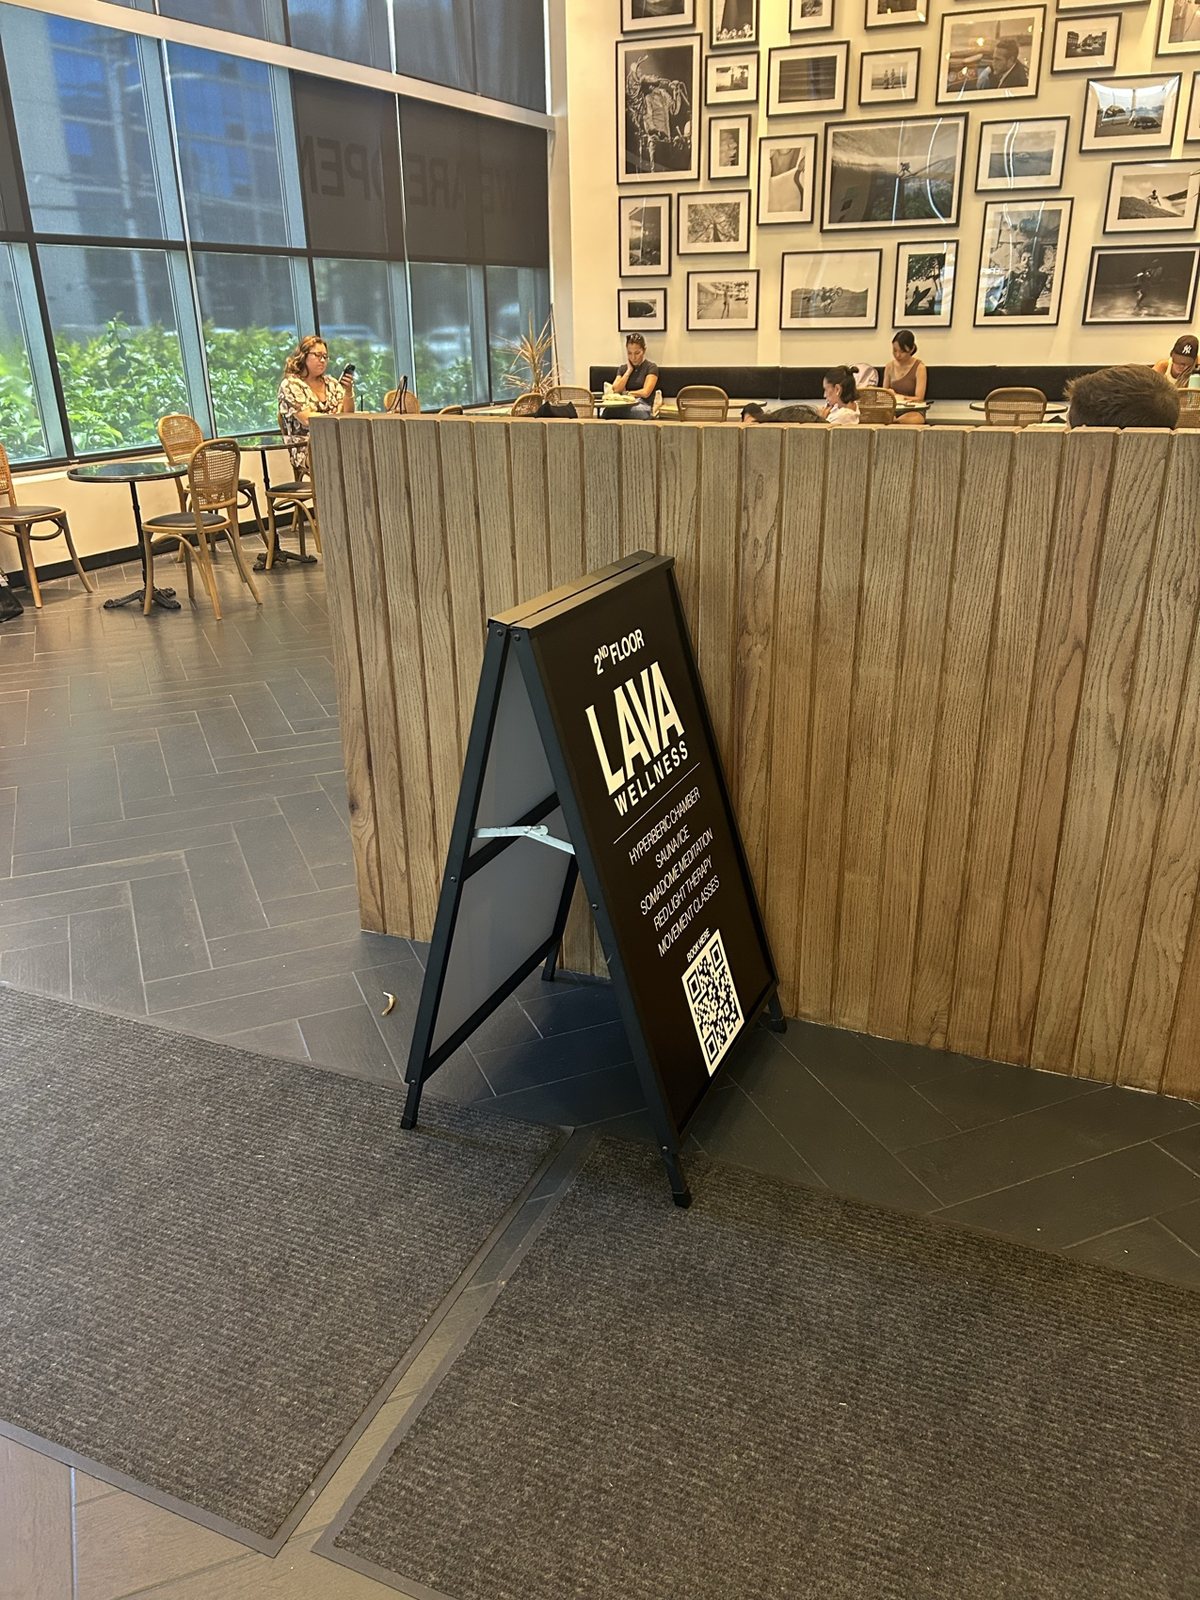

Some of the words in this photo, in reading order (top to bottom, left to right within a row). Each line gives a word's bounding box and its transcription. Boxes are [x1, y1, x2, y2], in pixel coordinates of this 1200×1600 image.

[593, 644, 609, 675] 2ND
[609, 628, 645, 665] FLOOR
[585, 661, 685, 796] LAVA
[614, 740, 688, 817] WELLNESS
[628, 814, 672, 866] HYPERBERIC
[670, 786, 701, 825] CHAMBER
[640, 863, 681, 916] SOMADOME
[678, 827, 714, 874] MEDITATION
[653, 908, 669, 932] RED
[667, 885, 687, 916] LIGHT
[684, 855, 713, 894] THERAPY
[657, 905, 695, 957] MOVEMENT
[693, 875, 720, 914] CLASSES
[686, 941, 700, 963] BOOK
